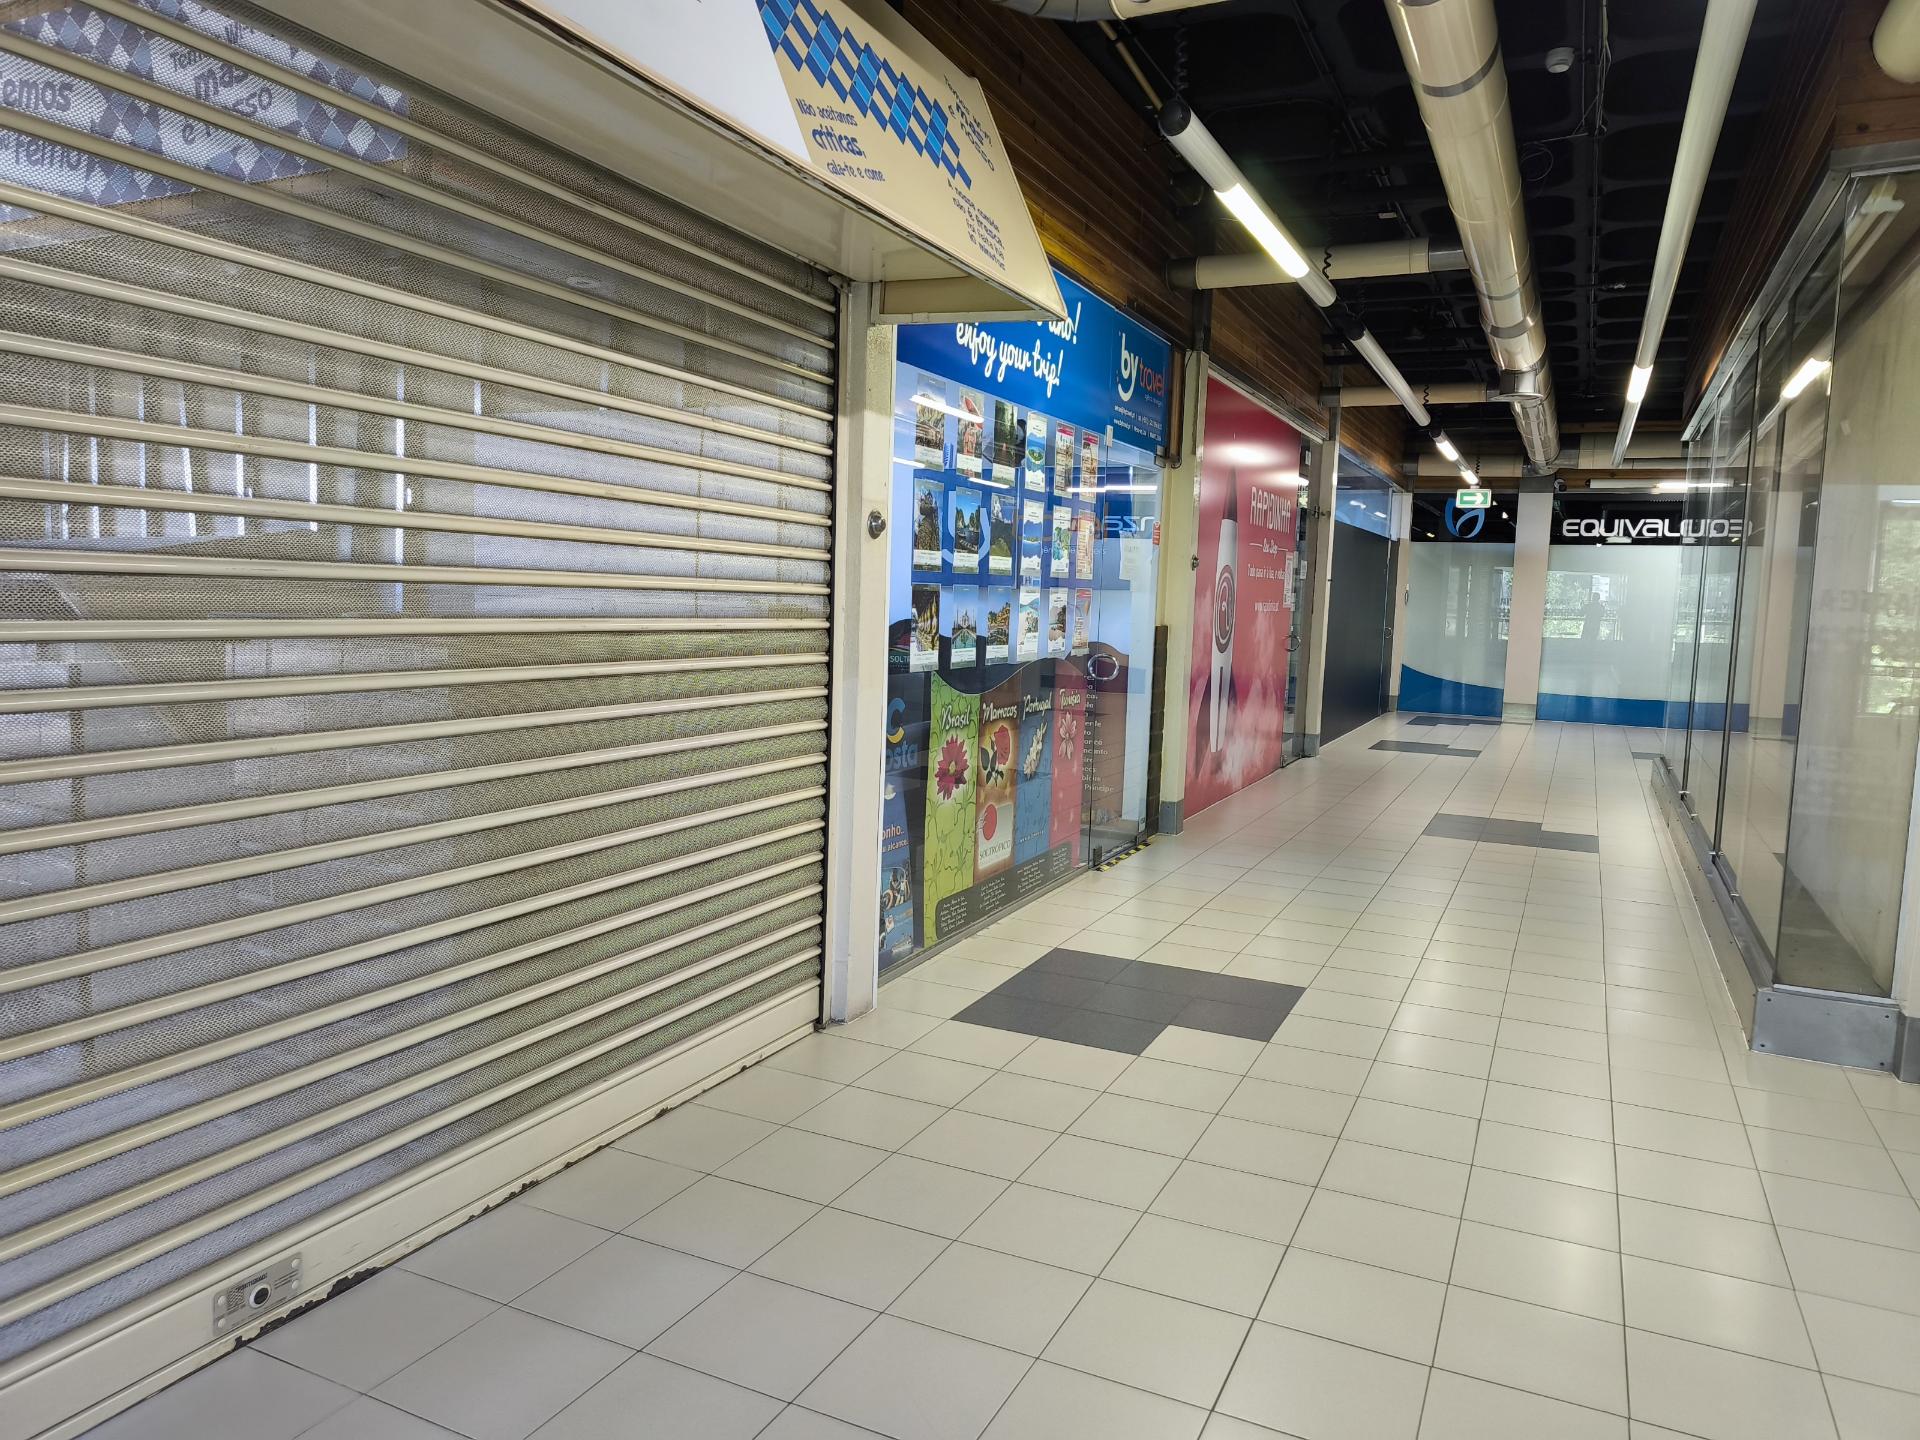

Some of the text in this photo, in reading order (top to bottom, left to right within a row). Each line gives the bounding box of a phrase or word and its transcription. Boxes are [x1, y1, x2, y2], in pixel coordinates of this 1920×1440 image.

[0, 74, 74, 113] emos
[795, 97, 858, 127] Não aceitamos
[826, 159, 857, 178] cala-te
[956, 321, 1064, 399] enjoy your trip!
[1117, 332, 1166, 402] by travel
[1249, 486, 1292, 534] RAPIDINHA
[941, 704, 972, 731] Brasil
[981, 702, 1018, 725] Marrocos
[1022, 690, 1054, 721] Portugal
